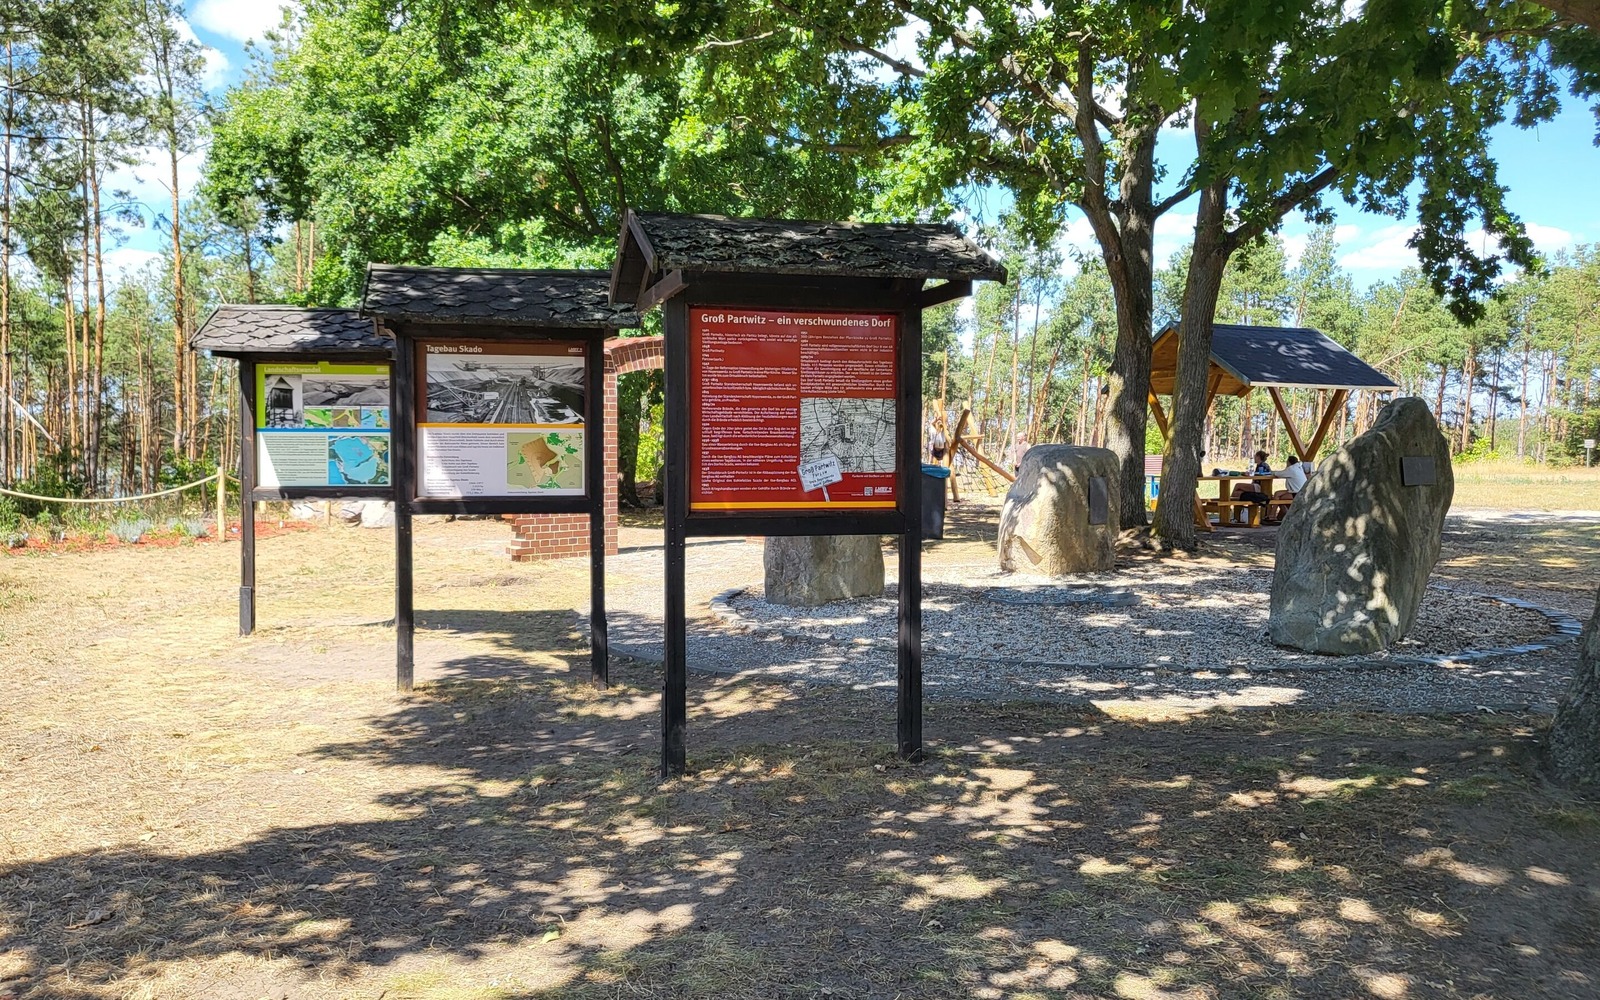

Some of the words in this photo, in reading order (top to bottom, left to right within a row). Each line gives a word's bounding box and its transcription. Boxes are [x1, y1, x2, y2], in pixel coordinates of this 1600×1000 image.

[701, 314, 724, 323] Groß
[727, 314, 766, 324] Partwitz
[776, 316, 791, 326] ein
[793, 317, 870, 328] verschwundenes
[872, 318, 891, 328] Dorf
[426, 345, 458, 354] Tagebau
